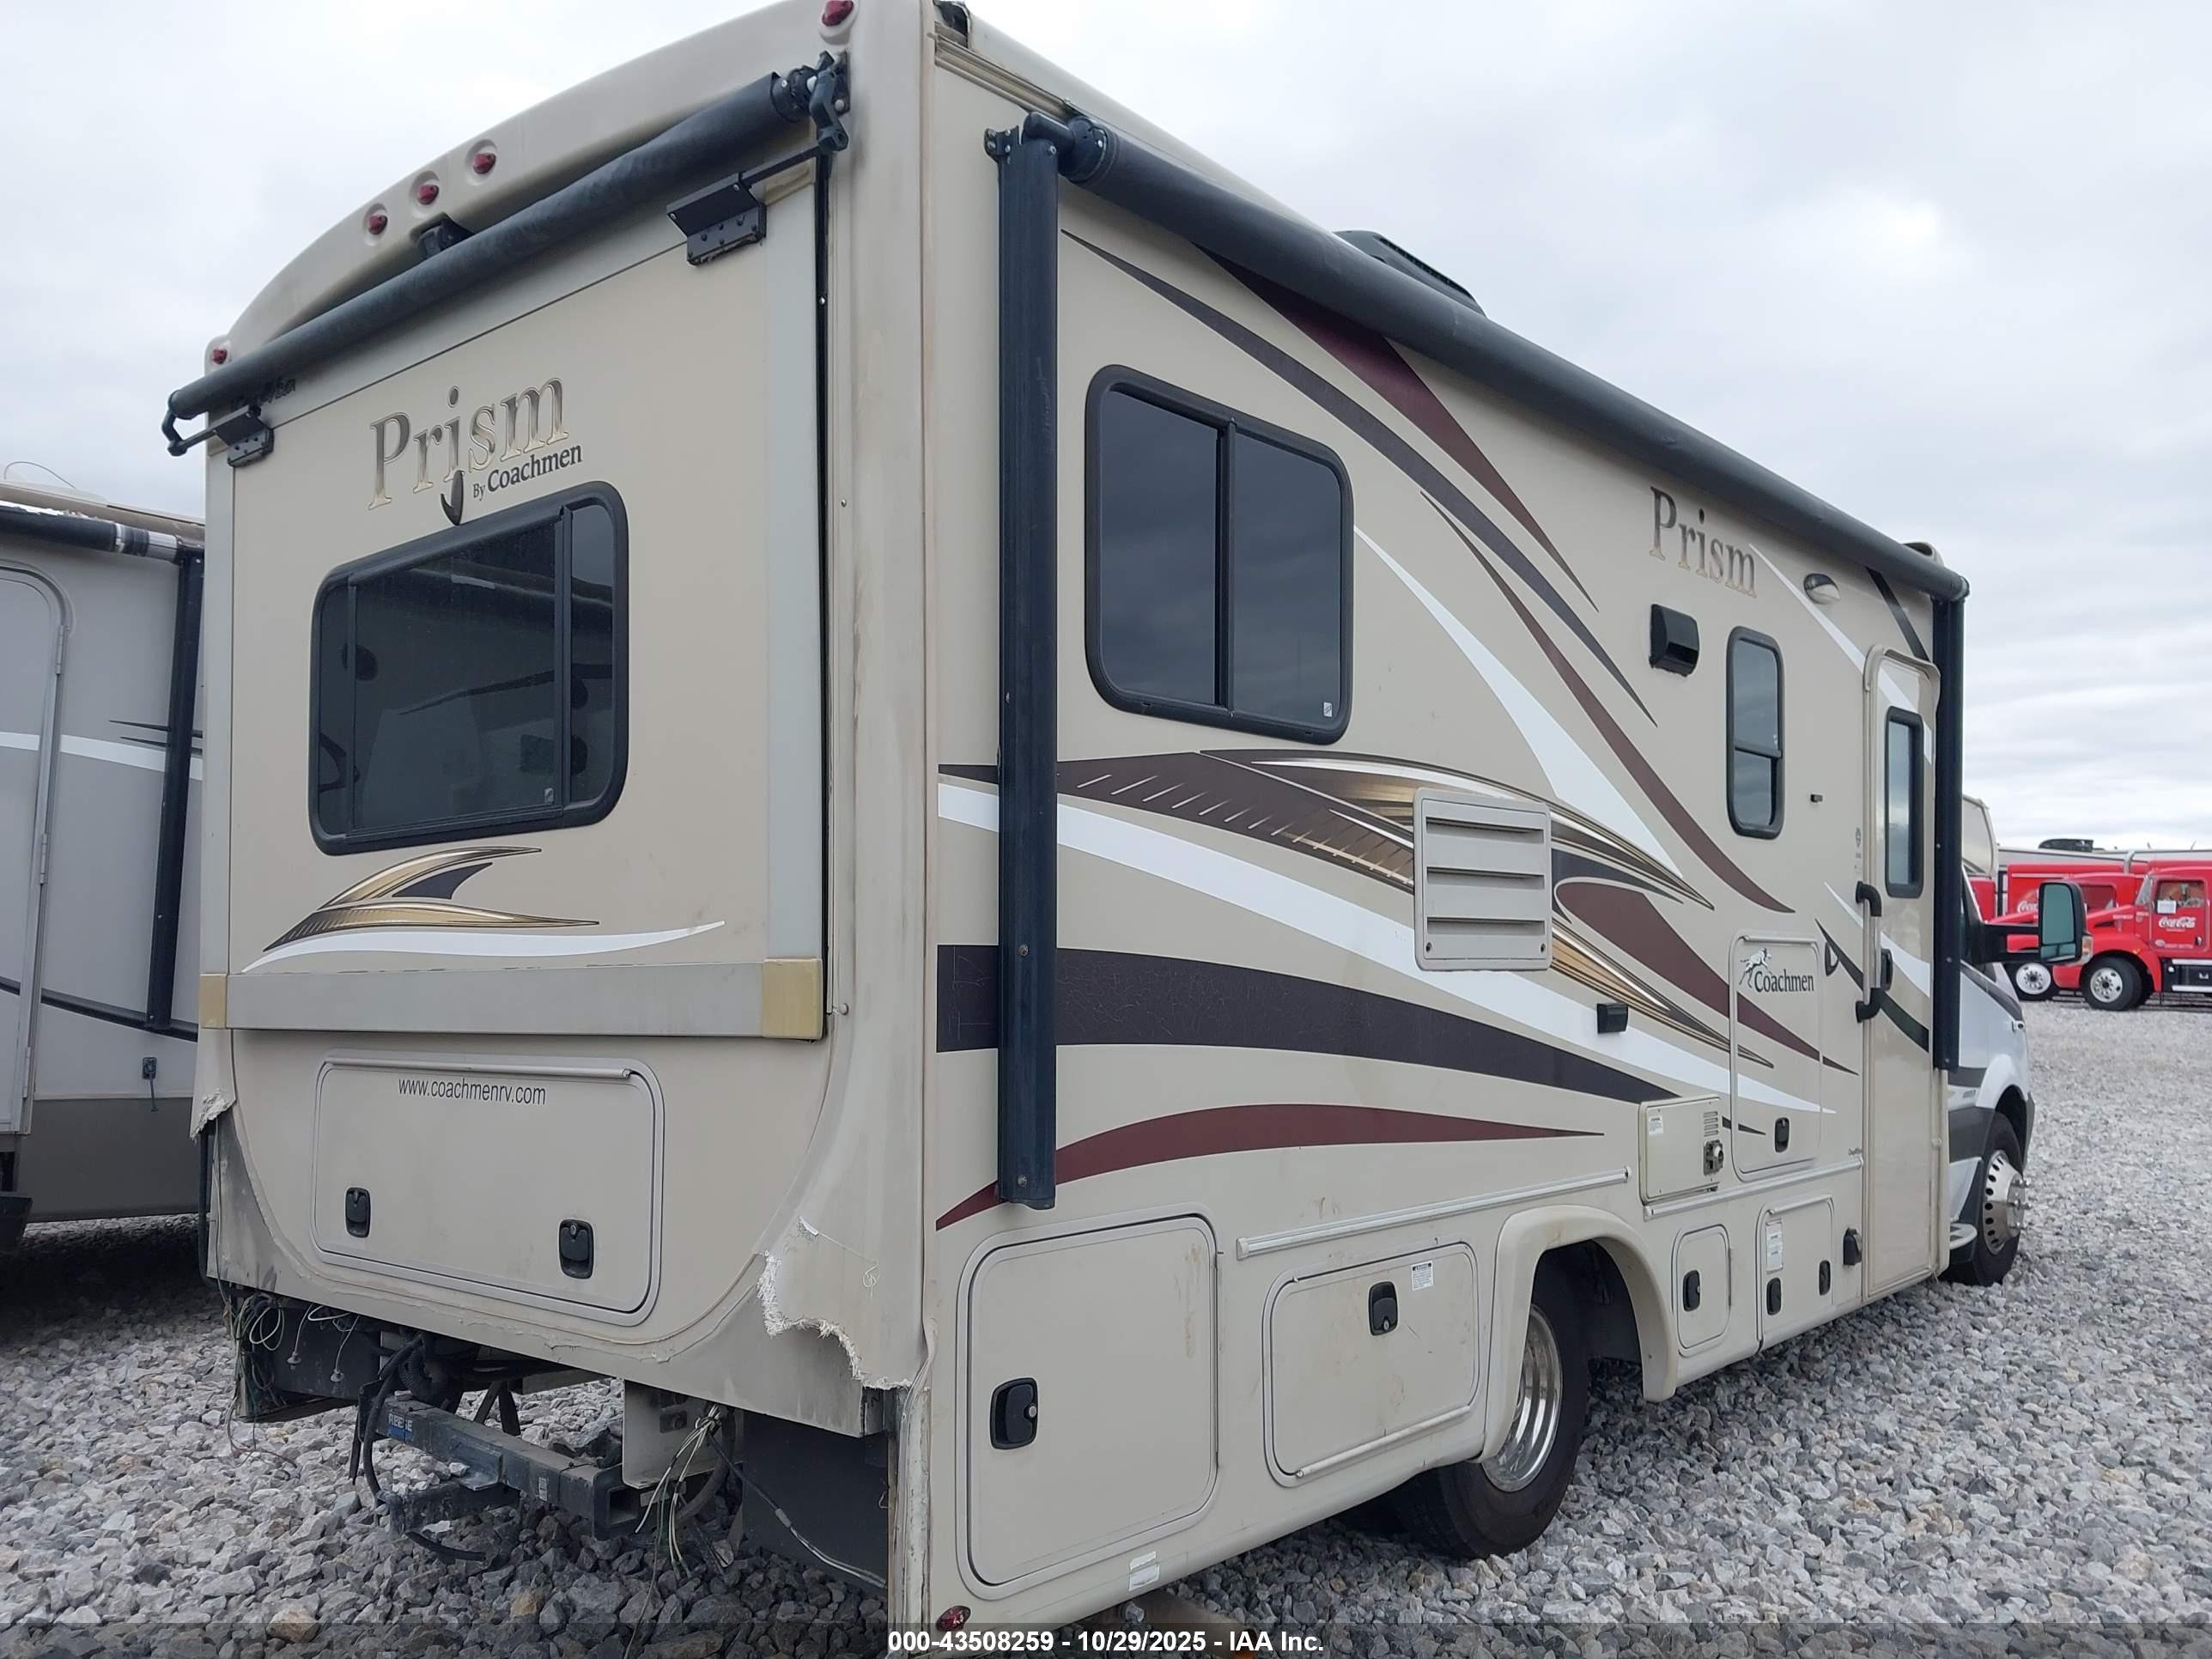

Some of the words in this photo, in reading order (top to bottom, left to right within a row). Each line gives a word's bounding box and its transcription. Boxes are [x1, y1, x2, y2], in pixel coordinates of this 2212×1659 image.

[368, 377, 570, 510] Prism
[472, 483, 486, 501] By
[487, 444, 583, 492] Coachmen
[1649, 486, 1757, 599] Prism
[1754, 969, 1814, 993] Coachmen
[398, 1078, 546, 1105] www.coachmenrv.com
